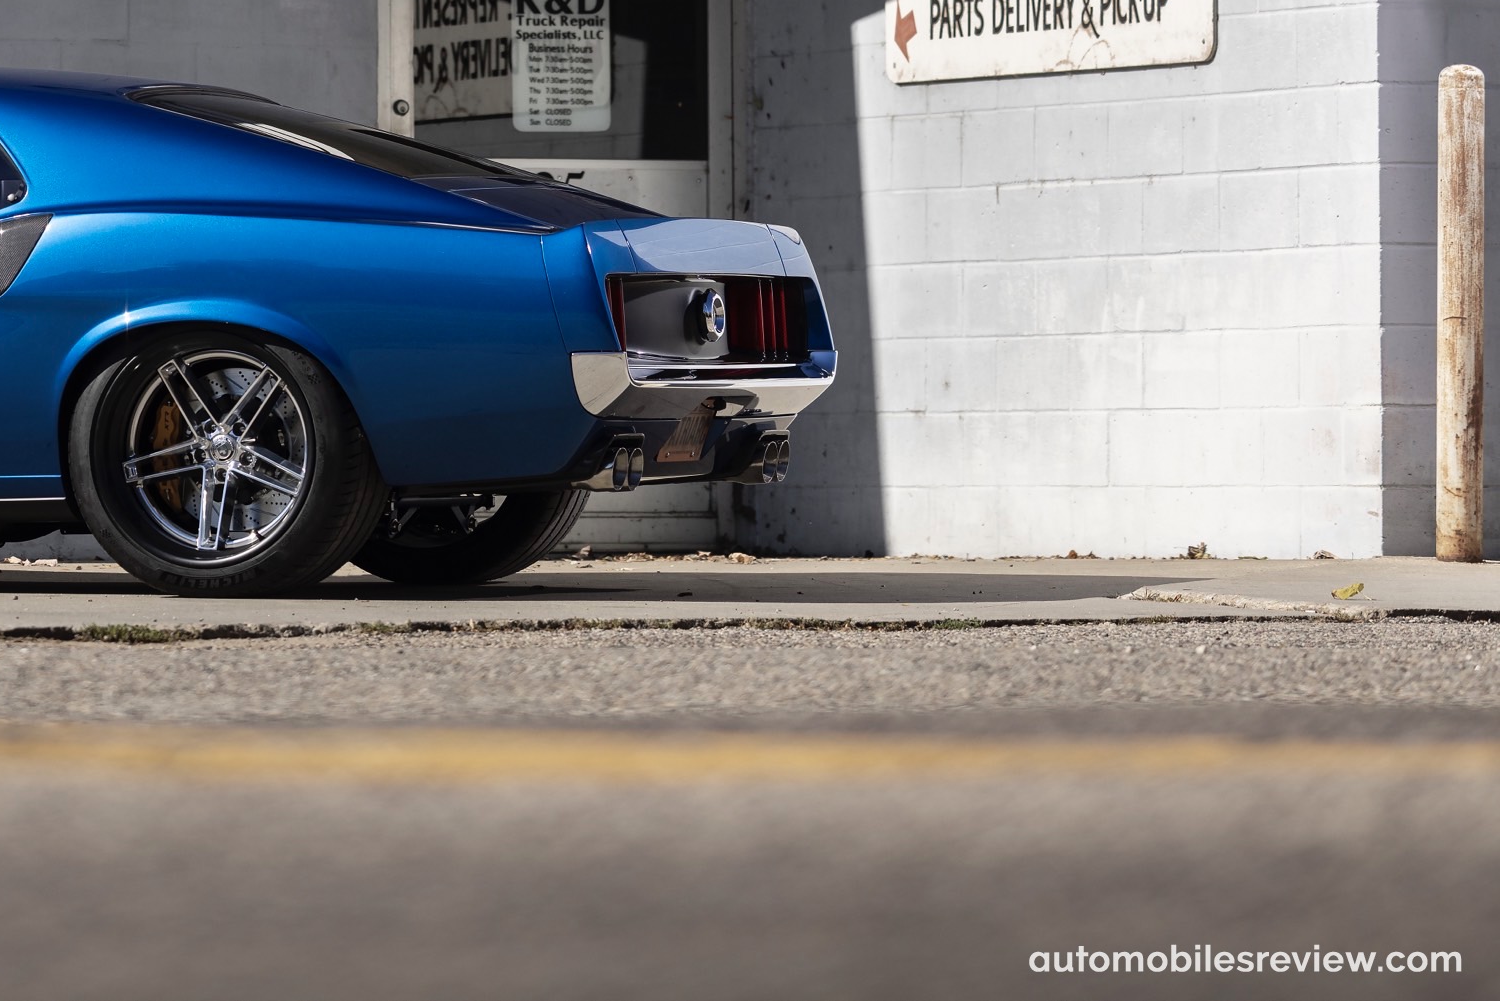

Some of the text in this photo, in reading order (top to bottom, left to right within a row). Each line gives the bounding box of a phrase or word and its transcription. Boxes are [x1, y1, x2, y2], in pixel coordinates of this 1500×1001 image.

[516, 15, 606, 29] Truck Repair
[515, 29, 604, 41] Specialists, LLC
[528, 43, 593, 54] Business Hours
[545, 108, 572, 116] CLOSED
[160, 569, 258, 588] MICHELIN
